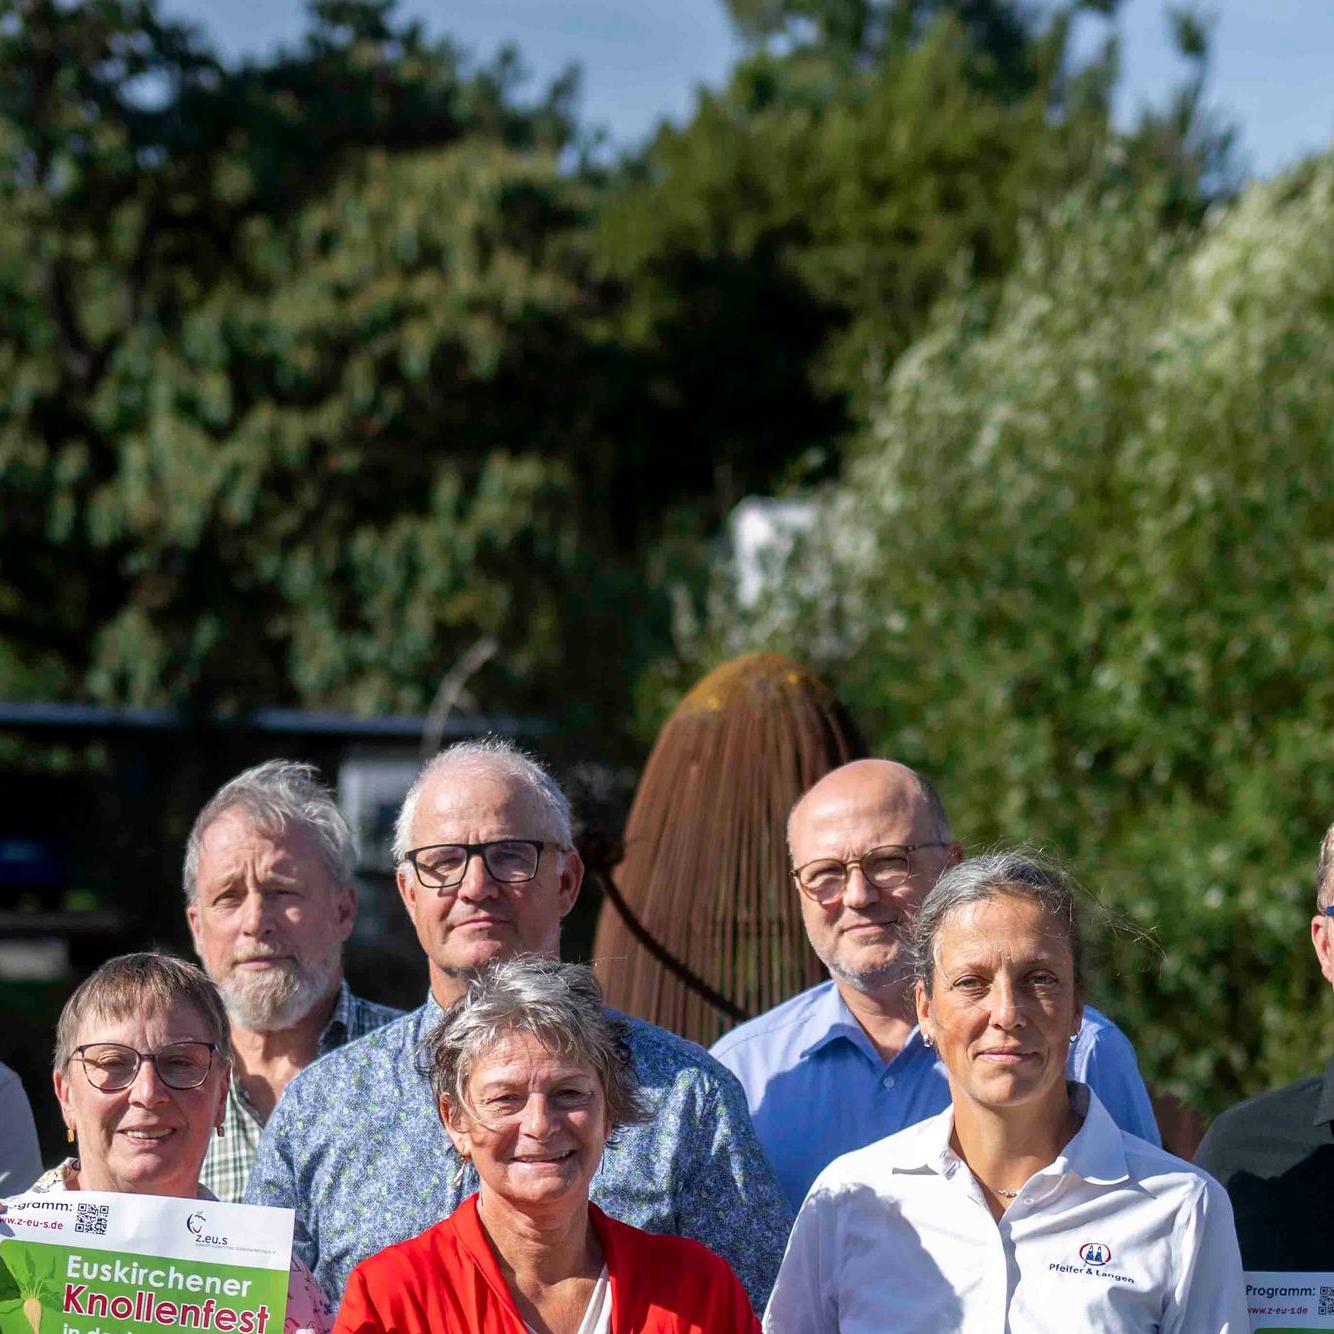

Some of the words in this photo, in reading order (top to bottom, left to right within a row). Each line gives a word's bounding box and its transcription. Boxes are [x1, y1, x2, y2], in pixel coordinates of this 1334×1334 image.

[195, 1233, 228, 1246] z.eu.s
[67, 1254, 252, 1298] Euskirchener
[1049, 1263, 1083, 1275] Pfeifer
[1096, 1270, 1135, 1284] Langen
[1246, 1284, 1316, 1299] Programm:
